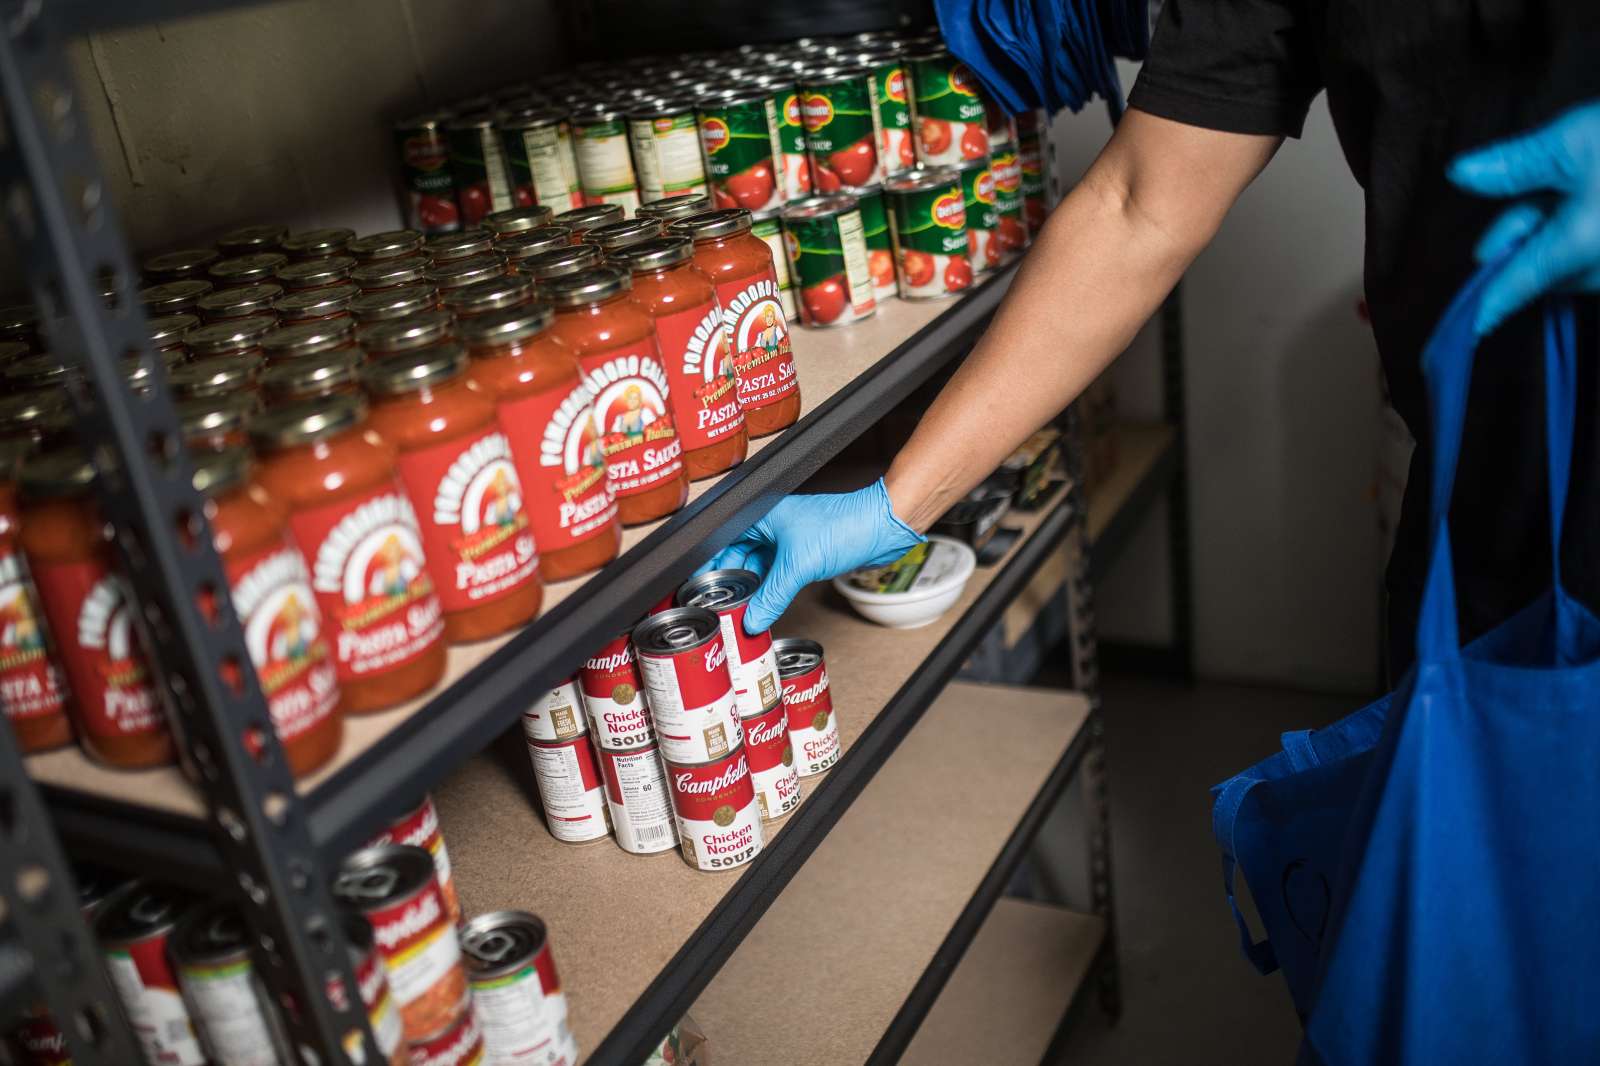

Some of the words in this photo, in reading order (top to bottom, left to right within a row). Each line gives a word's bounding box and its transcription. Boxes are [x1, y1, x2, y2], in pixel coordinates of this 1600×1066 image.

[697, 401, 737, 429] PASTA
[607, 458, 640, 479] STA
[607, 716, 651, 734] Noodl
[616, 755, 643, 763] Nutrition
[642, 783, 652, 792] 60
[703, 823, 752, 845] Chicken
[707, 834, 753, 855] Noodle
[710, 846, 754, 867] SOUP
